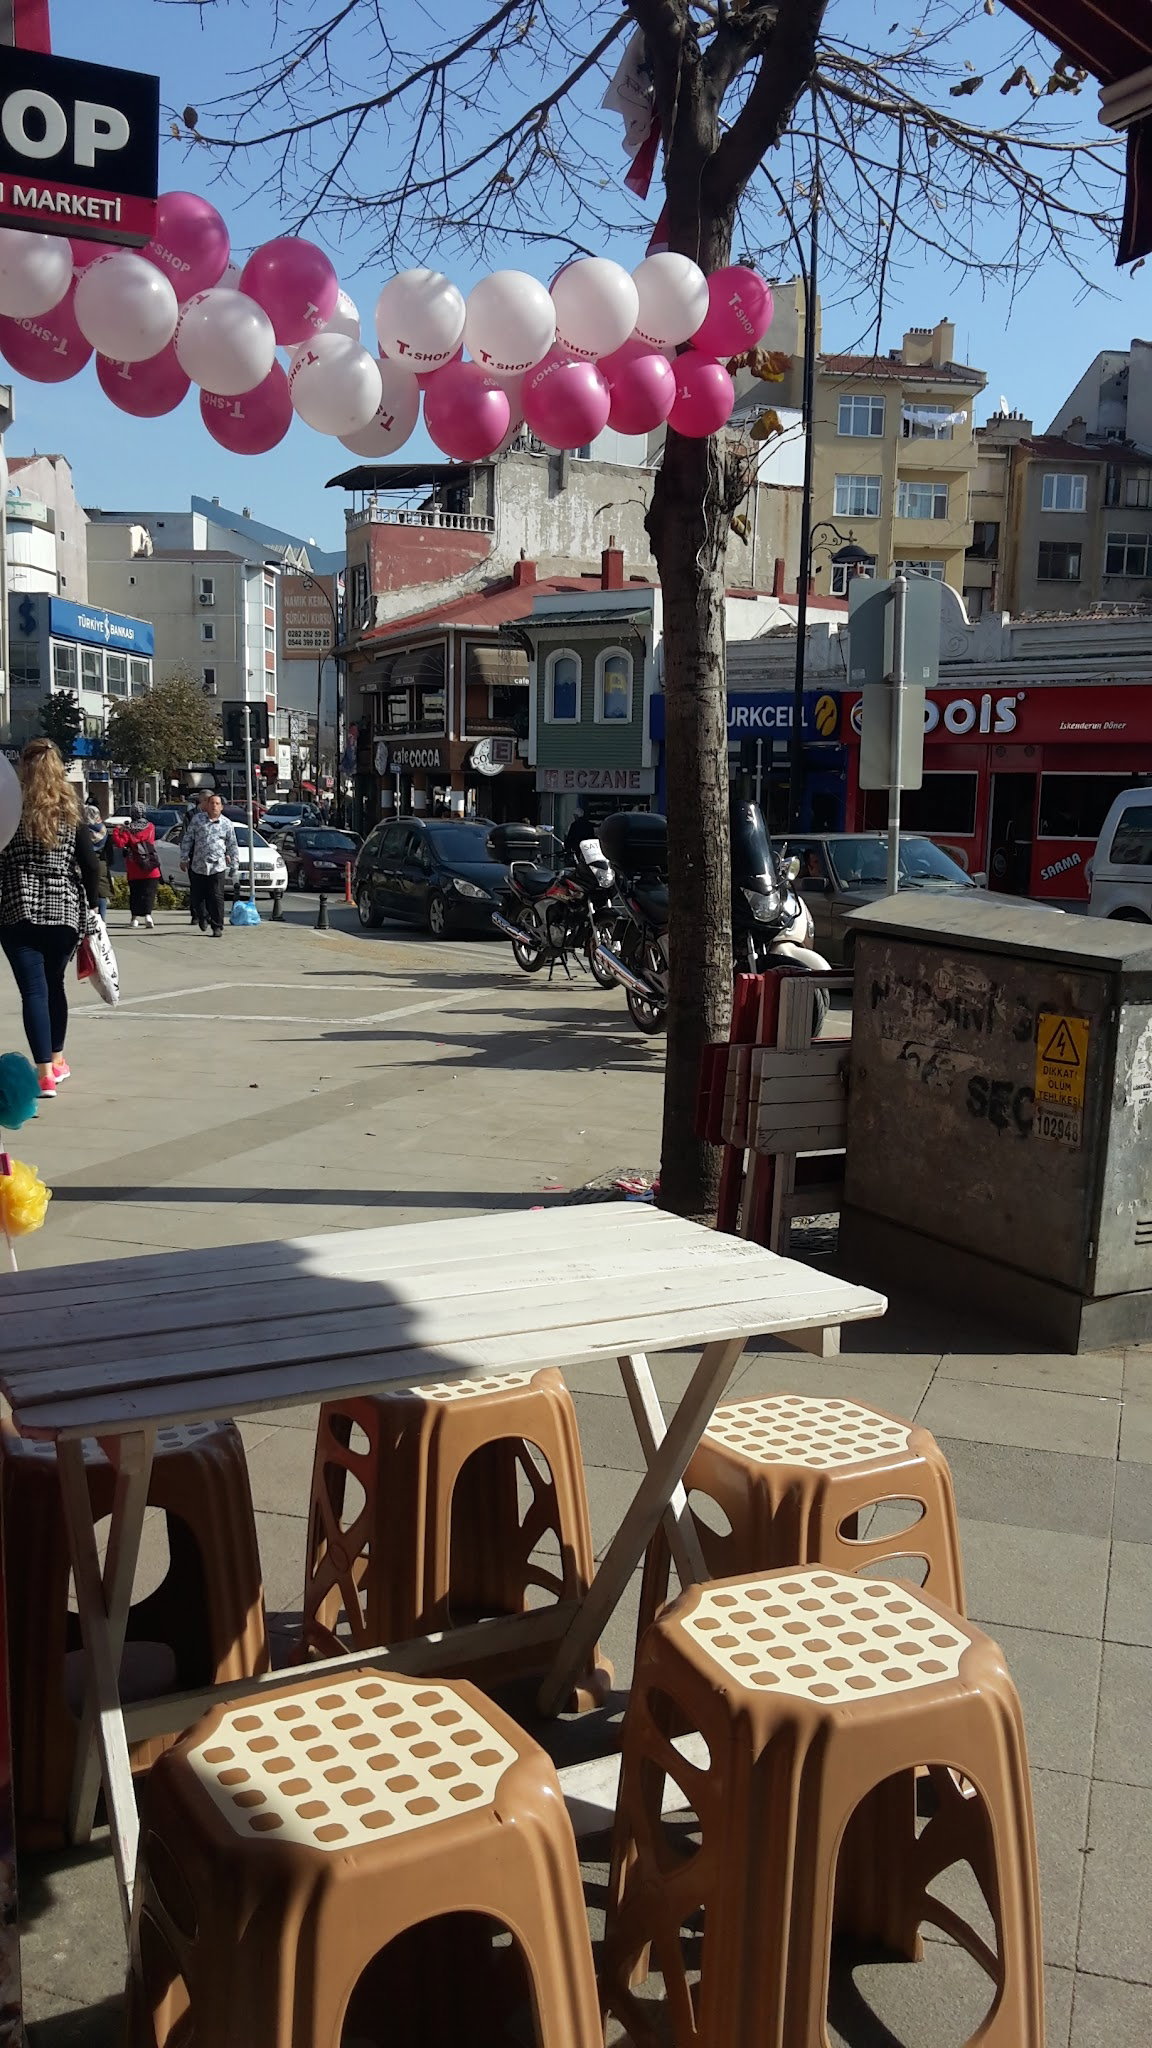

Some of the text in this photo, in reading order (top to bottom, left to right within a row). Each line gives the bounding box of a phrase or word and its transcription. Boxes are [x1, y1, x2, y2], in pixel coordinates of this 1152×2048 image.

[13, 185, 121, 221] MARKETİ
[77, 613, 135, 640] TÜRKİYE BANKASI
[288, 630, 302, 638] 0282
[314, 630, 322, 638] 59
[1103, 721, 1127, 730] Döner
[410, 748, 440, 768] COCOA
[563, 770, 641, 789] ECZANE
[1040, 853, 1082, 881] SARMA
[1037, 1115, 1078, 1142] 102948
